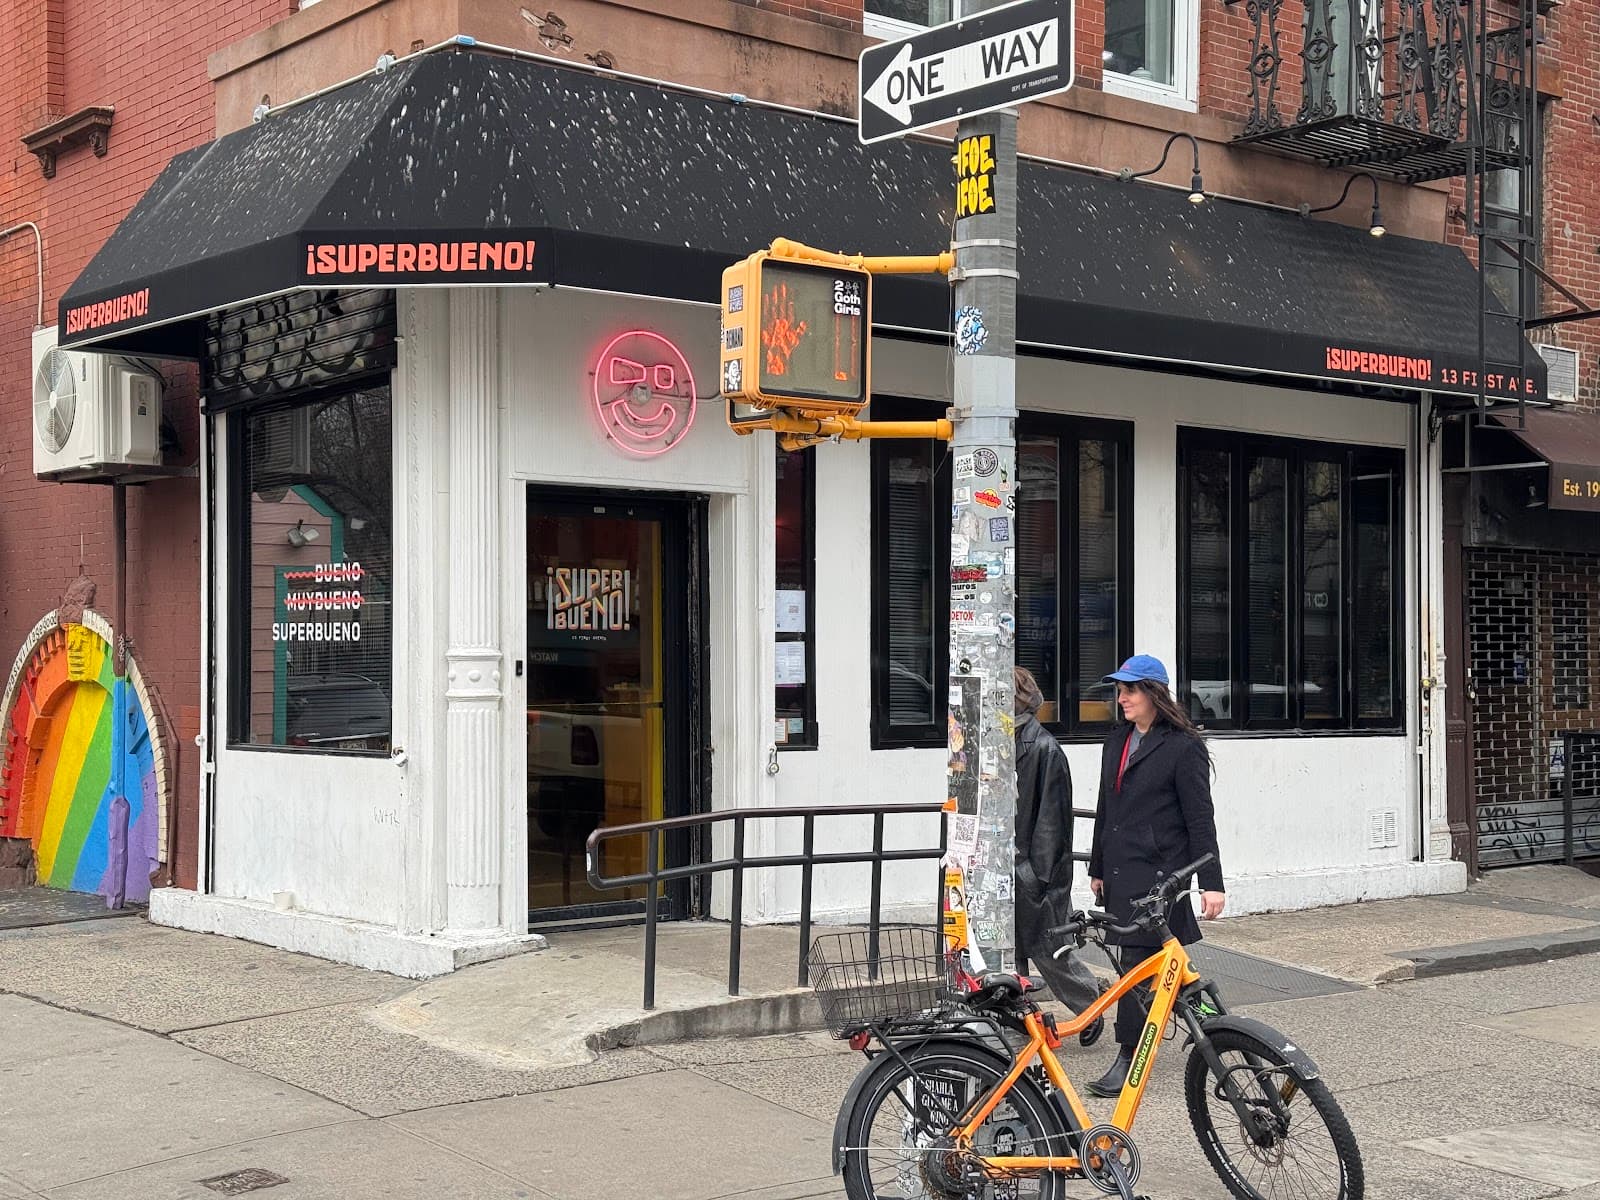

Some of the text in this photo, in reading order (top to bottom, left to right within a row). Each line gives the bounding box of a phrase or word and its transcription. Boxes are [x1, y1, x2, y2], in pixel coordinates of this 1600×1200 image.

[886, 25, 1051, 105] ONE WAY
[306, 240, 536, 275] ¡SUPERBUENO!
[834, 280, 844, 291] 2
[834, 292, 861, 305] Goth
[66, 287, 150, 335] ¡SUPERBUENO!
[834, 303, 861, 316] Girls
[1326, 347, 1538, 394] ¡SUPERBUENO! 13 FIST AE.
[1563, 478, 1600, 498] Est. 19
[315, 562, 361, 582] BUENO
[951, 610, 974, 621] DETOX
[272, 621, 361, 641] SUPERBUENO
[1131, 1024, 1157, 1086] getwhizz.com
